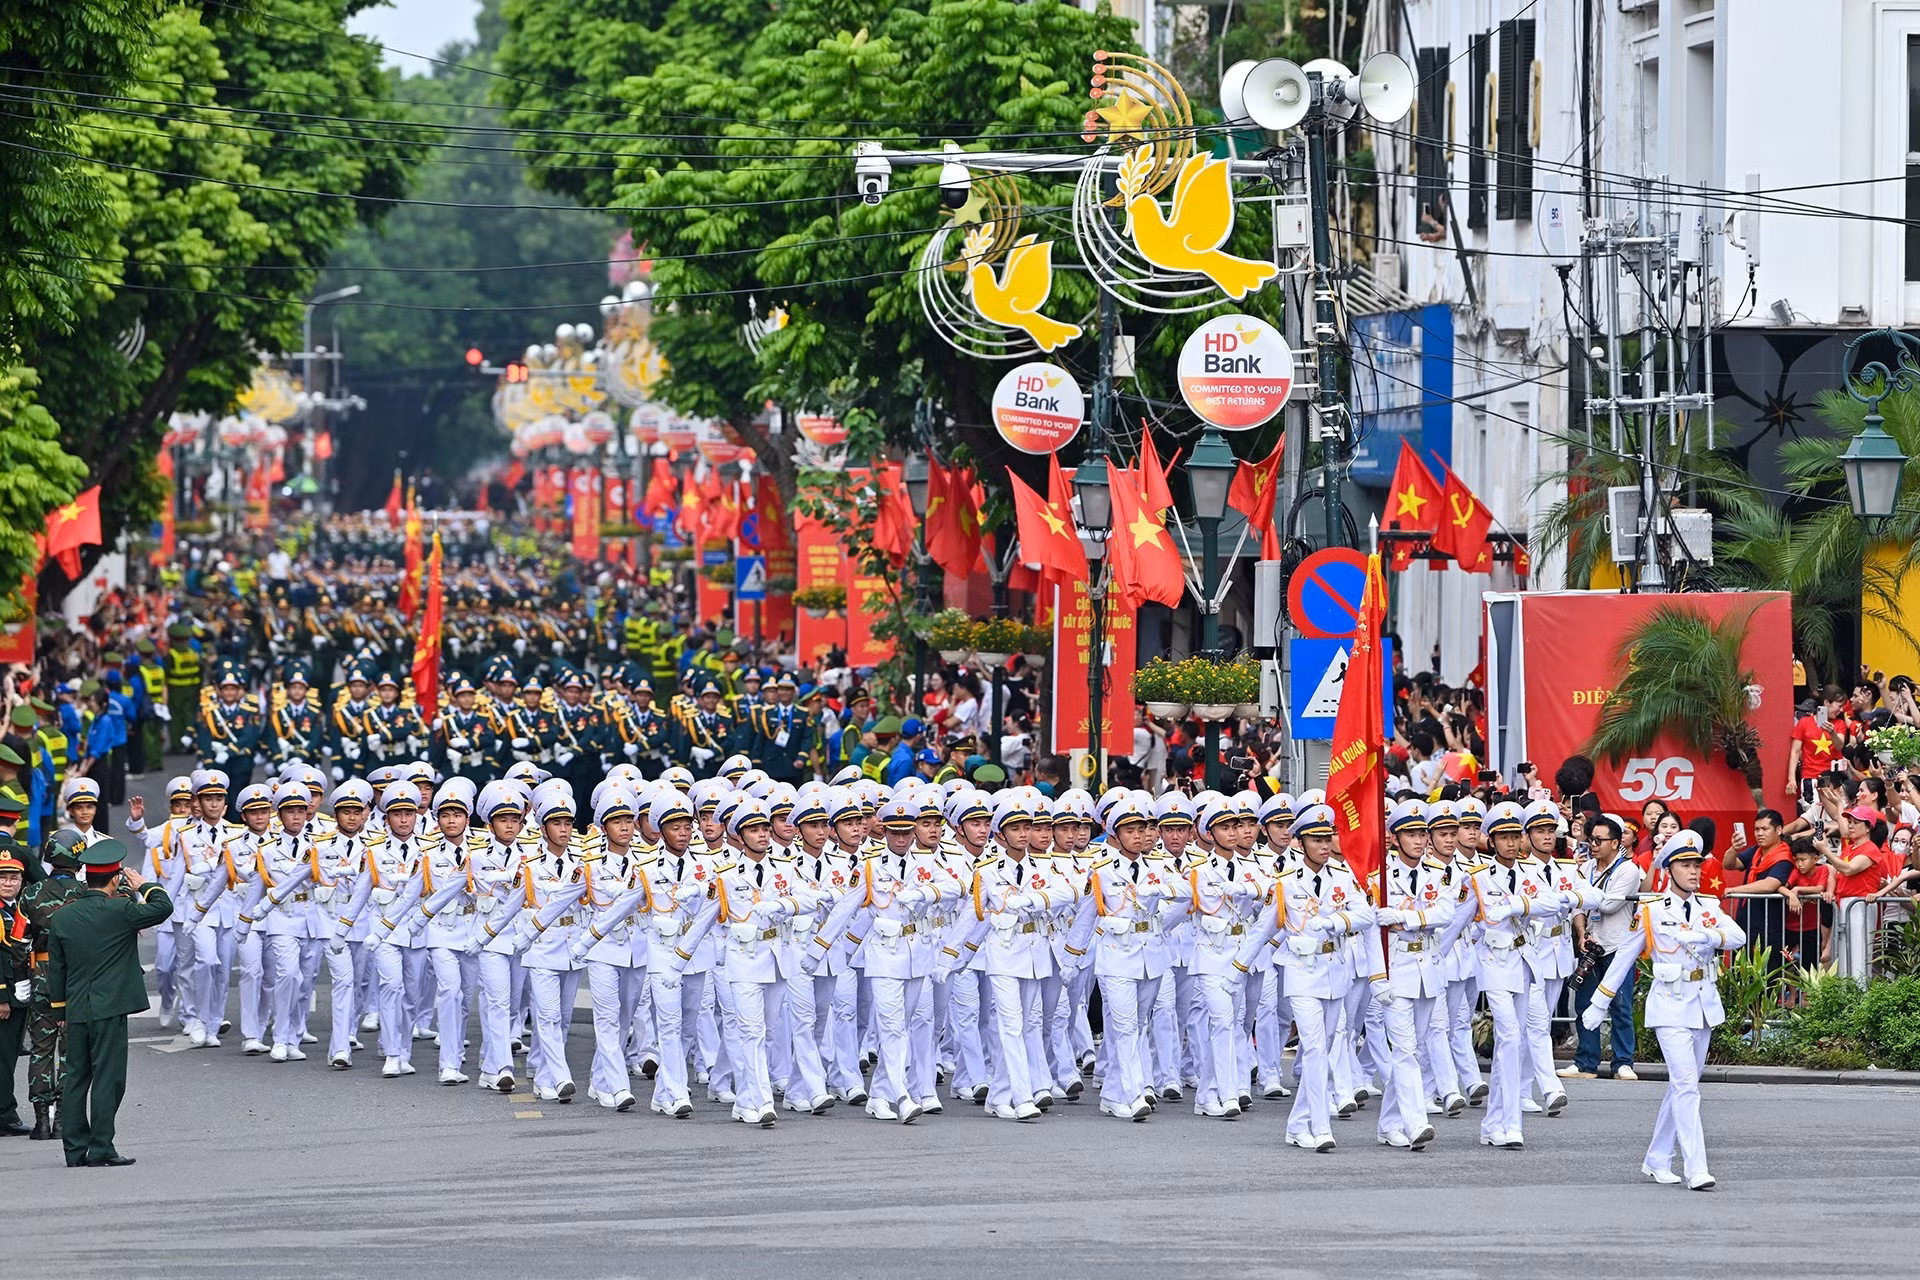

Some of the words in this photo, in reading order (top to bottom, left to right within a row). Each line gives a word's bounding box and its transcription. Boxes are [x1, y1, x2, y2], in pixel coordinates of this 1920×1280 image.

[1205, 333, 1238, 352] HD
[1204, 353, 1262, 373] Bank
[1017, 375, 1044, 392] HD
[1190, 384, 1242, 394] COMMITTED
[1243, 385, 1256, 394] TO
[1258, 385, 1282, 394] YOUR
[1015, 391, 1060, 412] Bank
[1205, 396, 1226, 405] BEST
[1227, 397, 1266, 406] RETURNS
[1001, 413, 1043, 426] COMMITTED
[1043, 419, 1053, 428] TO
[1053, 421, 1074, 431] YOUR
[1012, 424, 1029, 434] BEST
[1029, 427, 1060, 438] RETURNS
[1619, 756, 1694, 802] 5G
